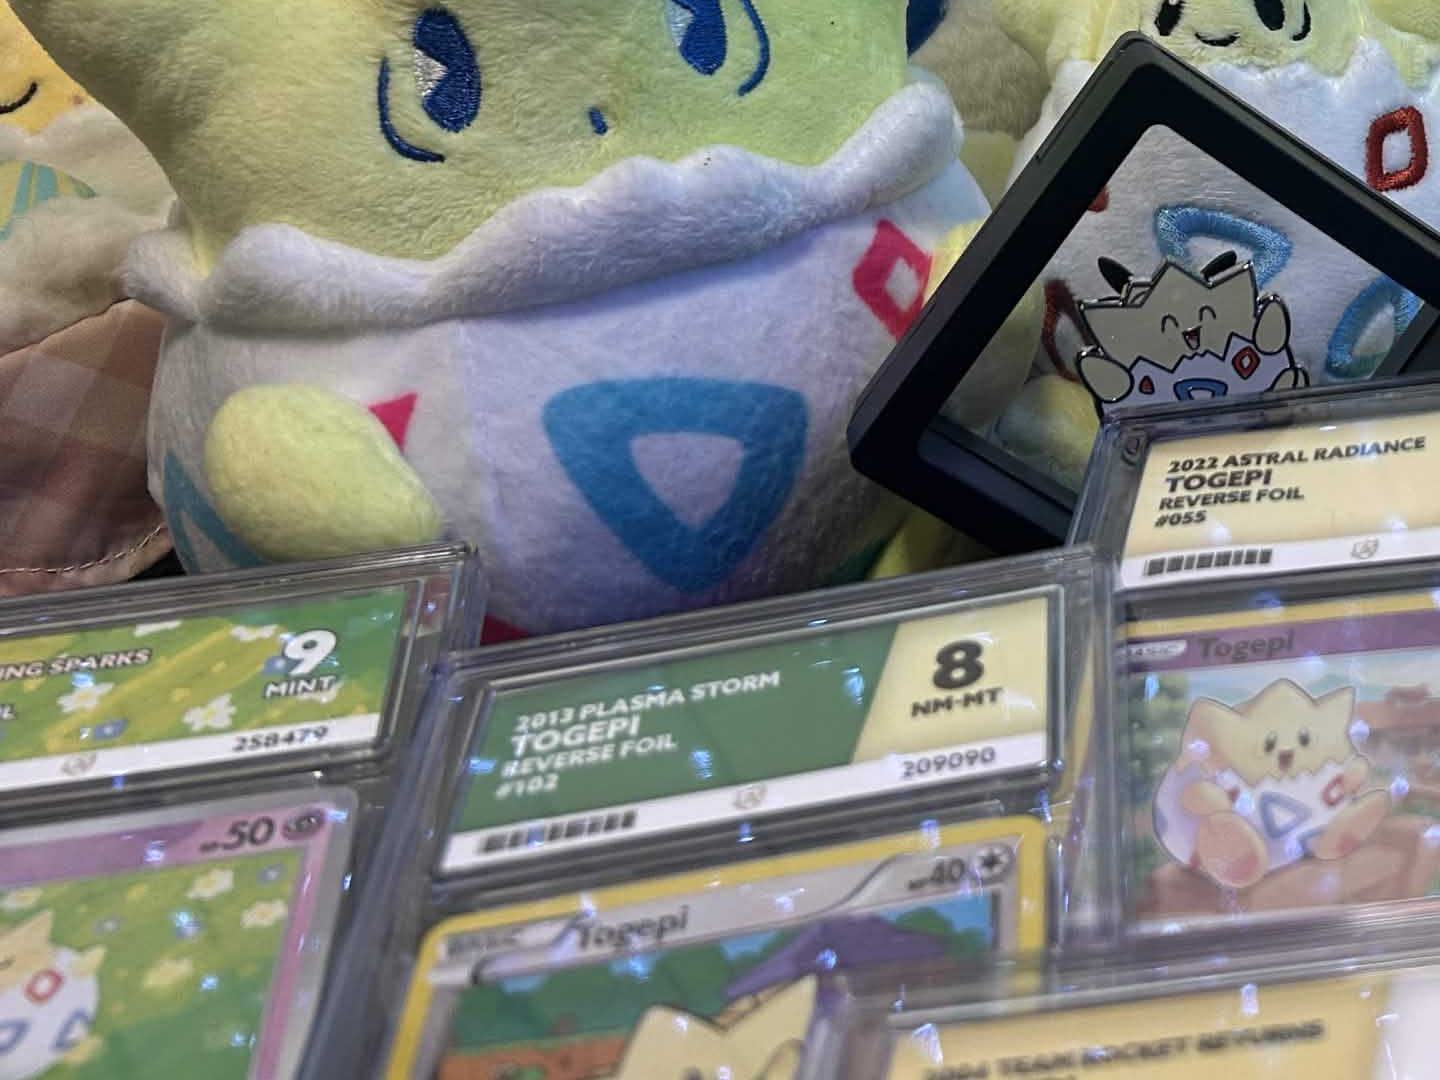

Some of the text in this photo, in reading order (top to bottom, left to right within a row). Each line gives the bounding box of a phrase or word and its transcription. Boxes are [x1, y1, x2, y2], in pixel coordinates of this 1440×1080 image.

[1168, 435, 1427, 473] 2022 ASTRAL RADIANCE
[1164, 468, 1273, 494] TOGEPI
[1157, 487, 1305, 511] REVERSE FOIL
[1153, 510, 1207, 528] #055
[48, 647, 153, 675] SPARKS
[284, 630, 338, 676] 9
[1198, 629, 1297, 664] Togepi
[932, 639, 985, 690] 8
[263, 674, 336, 700] MINT
[514, 670, 781, 734] 2013 PLASMA STORM
[911, 686, 1003, 717] NM-MT
[233, 725, 329, 753] 258479
[509, 714, 641, 758] TOGEPI
[501, 732, 678, 777] REVERSE FOIL
[902, 746, 997, 778] 209090
[218, 816, 275, 850] 50
